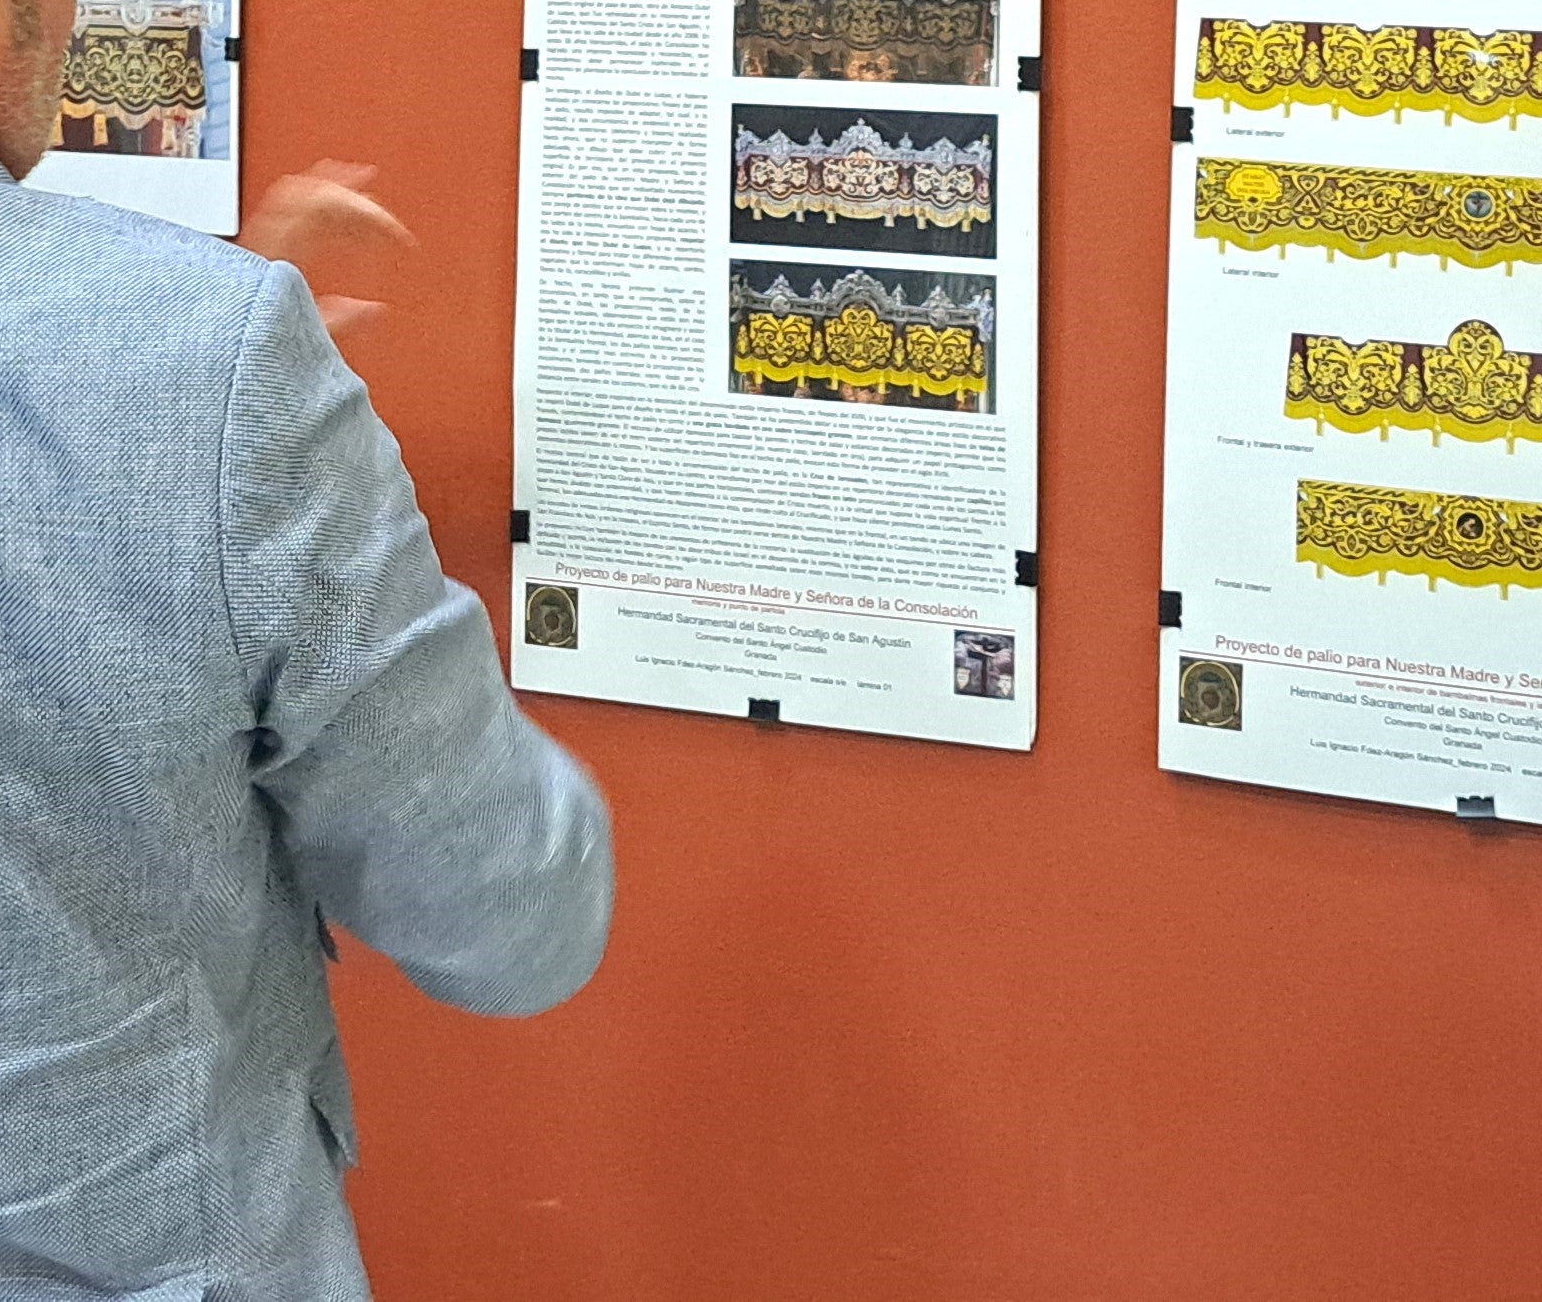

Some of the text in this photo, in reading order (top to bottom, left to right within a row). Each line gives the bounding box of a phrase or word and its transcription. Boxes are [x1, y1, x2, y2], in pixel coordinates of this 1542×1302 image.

[555, 561, 978, 620] Proyecto de palio para Nuestra Madre y Señora de la Consolación
[617, 606, 911, 648] Hermandad Sacramental del Santo Crucifijo de San Agustín
[1215, 634, 1280, 656] Proyecto
[1283, 644, 1303, 659] de
[1306, 649, 1342, 664] palio
[1346, 655, 1381, 670] para
[1385, 656, 1446, 677] Nuestra
[1450, 664, 1500, 684] Madre
[1504, 674, 1514, 689] y
[1289, 685, 1357, 704] Hermandad
[1360, 694, 1434, 715] Sacramental
[1436, 705, 1456, 717] del
[1458, 707, 1495, 722] Santo
